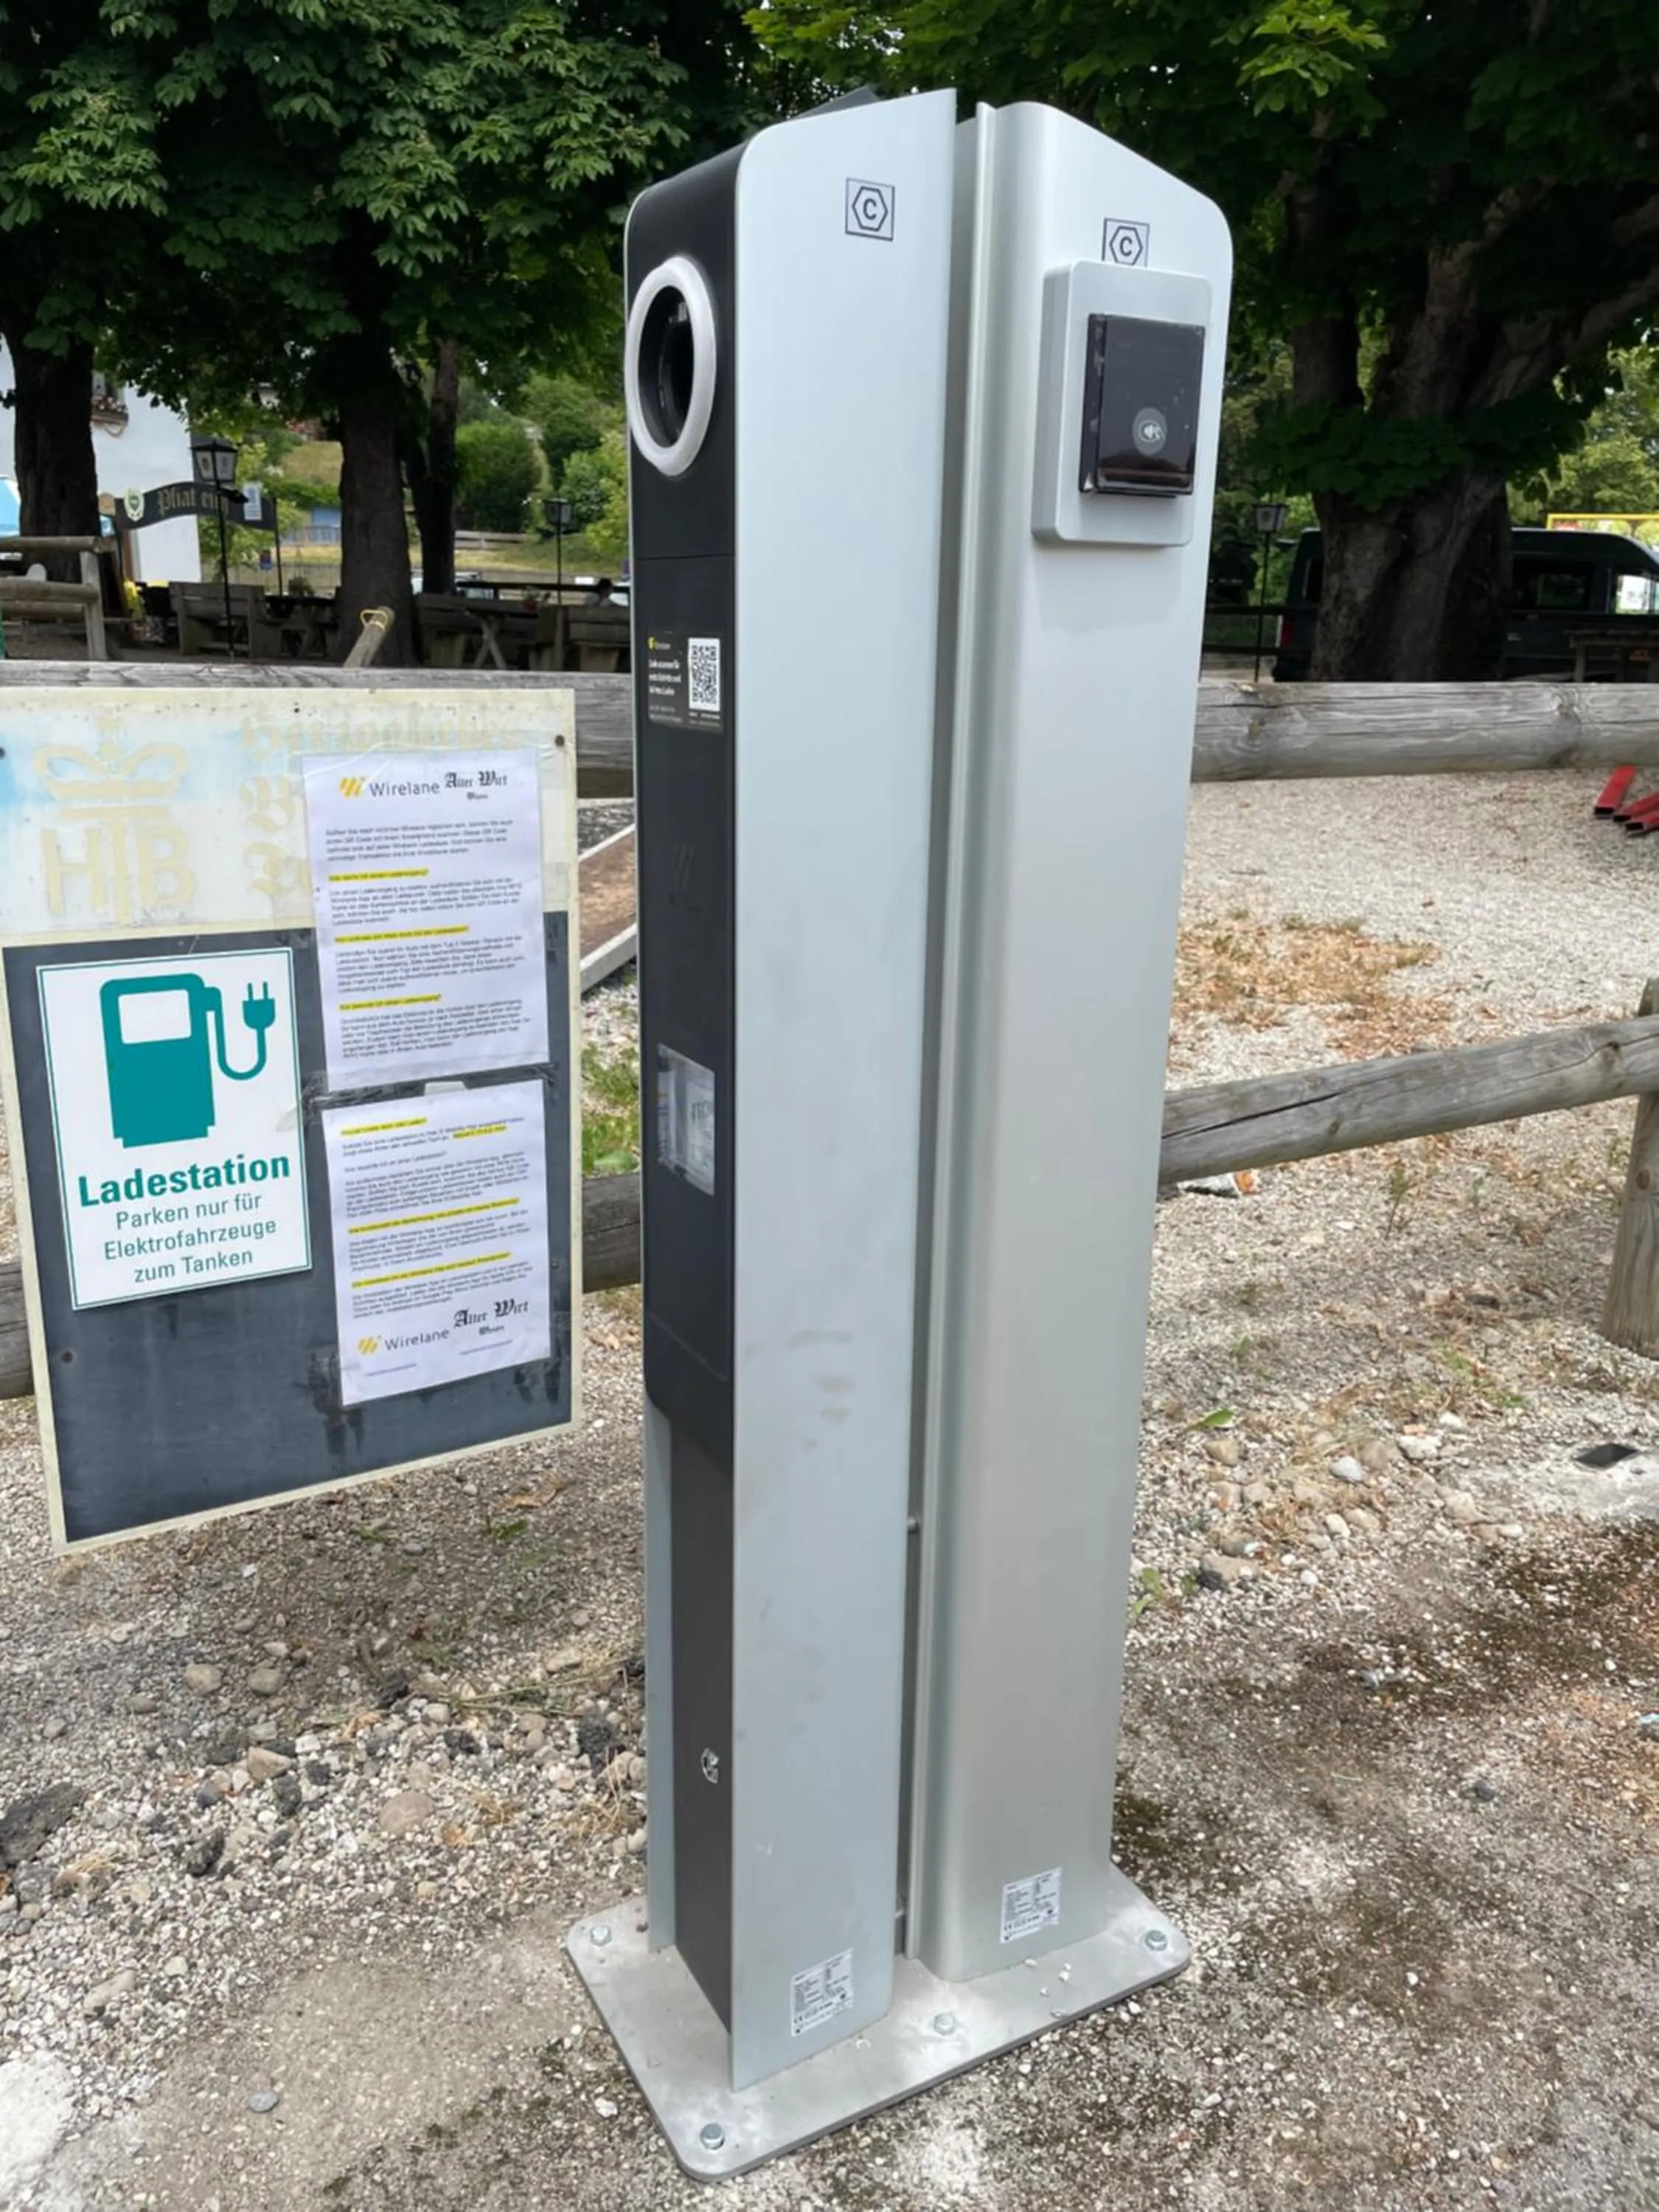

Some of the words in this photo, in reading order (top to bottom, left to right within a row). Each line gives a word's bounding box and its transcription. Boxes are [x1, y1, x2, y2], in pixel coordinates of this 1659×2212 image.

[369, 781, 440, 797] Wirelane
[78, 1154, 291, 1207] Ladestation
[116, 1203, 189, 1229] Parken
[196, 1201, 228, 1219] nur
[234, 1193, 262, 1212] für
[104, 1219, 277, 1260] Elektrofahrzeuge
[134, 1264, 175, 1283] zum
[181, 1251, 253, 1275] Tanken
[384, 1328, 449, 1352] Wirelane
